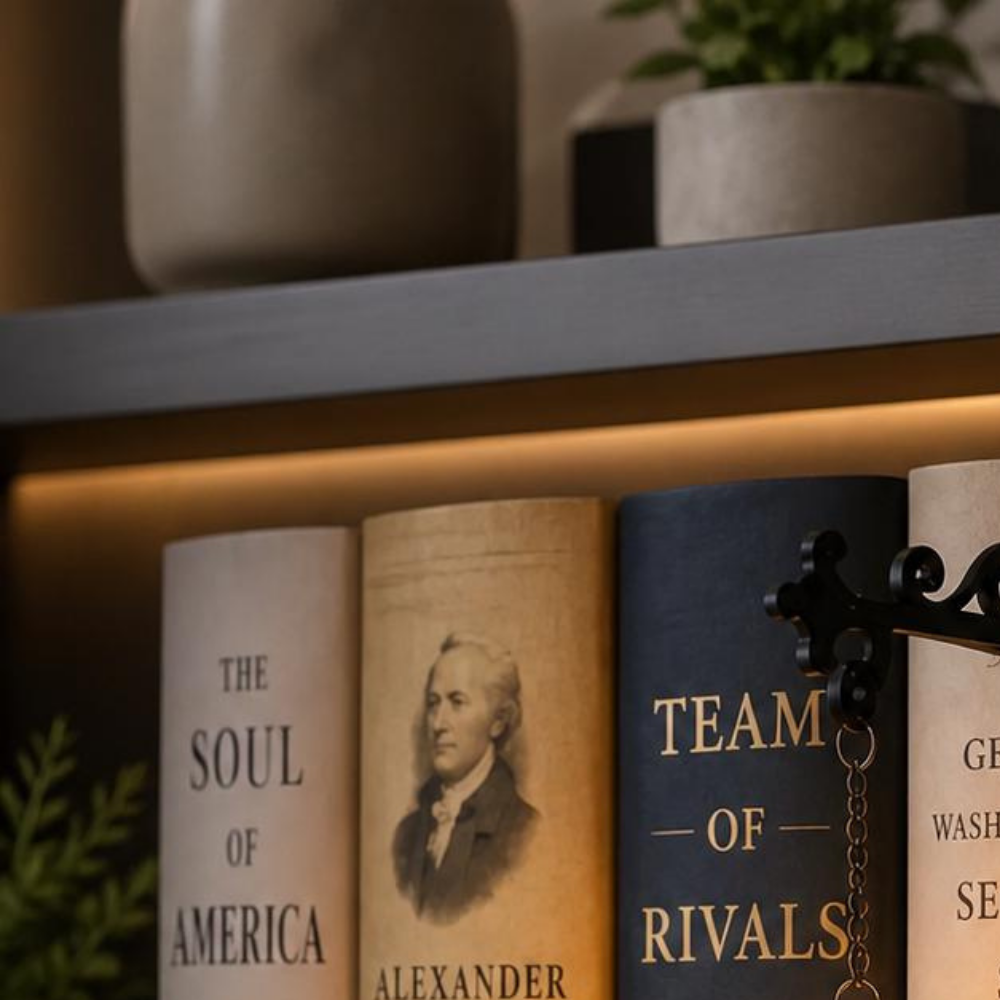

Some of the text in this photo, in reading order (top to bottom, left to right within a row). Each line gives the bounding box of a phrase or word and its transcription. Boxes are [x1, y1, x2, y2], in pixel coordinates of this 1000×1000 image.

[219, 655, 268, 690] THE
[653, 688, 826, 755] TEAM
[189, 724, 303, 790] SOUL
[225, 827, 258, 866] OF
[706, 807, 765, 851] OF
[169, 903, 325, 965] AMERICA
[641, 901, 850, 962] RIVALS
[374, 963, 566, 1000] ALEXANDER
